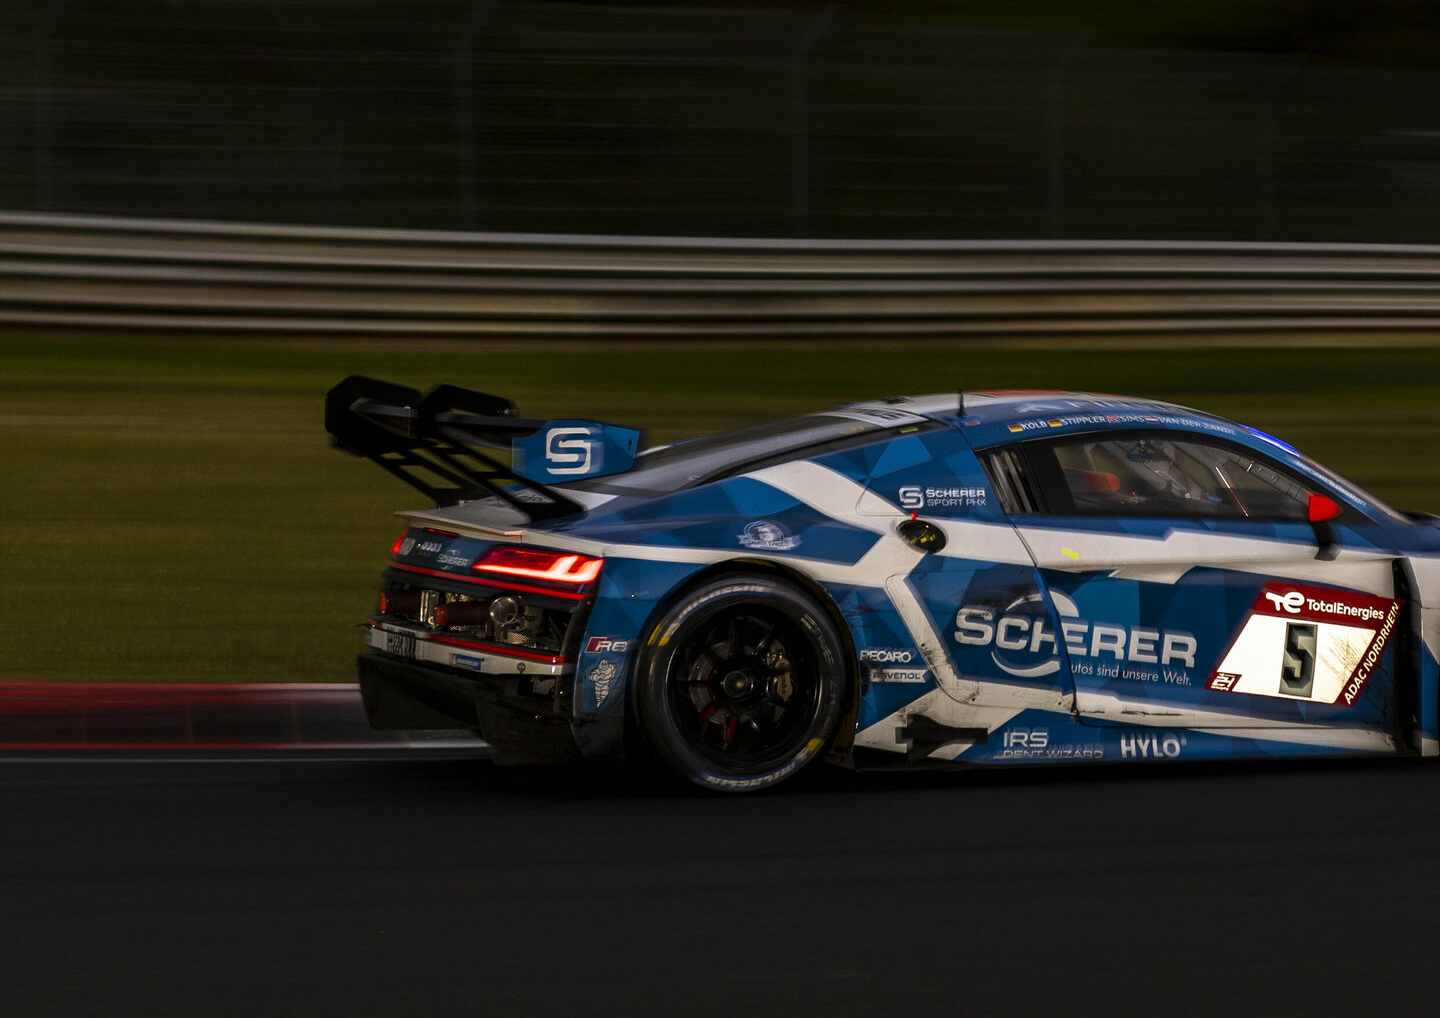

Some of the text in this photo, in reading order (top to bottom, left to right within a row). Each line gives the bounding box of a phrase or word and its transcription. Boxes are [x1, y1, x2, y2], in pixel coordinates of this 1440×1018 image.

[1021, 420, 1047, 430] KOLB
[1062, 415, 1106, 426] STIPPLER
[1120, 415, 1145, 423] SIMS
[1158, 415, 1179, 424] VAN
[925, 489, 985, 498] SCHERER
[927, 498, 986, 507] SPORT PHX
[1306, 599, 1384, 620] TotalEnergies
[954, 608, 1198, 668] SCHERER
[594, 640, 628, 652] R8
[1344, 602, 1399, 705] ADAC NORDRHEIN
[860, 650, 911, 663] RECARO
[1282, 623, 1316, 696] 5
[873, 672, 921, 680] RAVENOL
[1070, 664, 1093, 675] utos
[1097, 664, 1120, 678] sind
[1122, 669, 1159, 682] unsere
[1163, 669, 1192, 686] Welt.
[1003, 731, 1048, 748] IRS
[1003, 749, 1104, 759] DENT WIZARD
